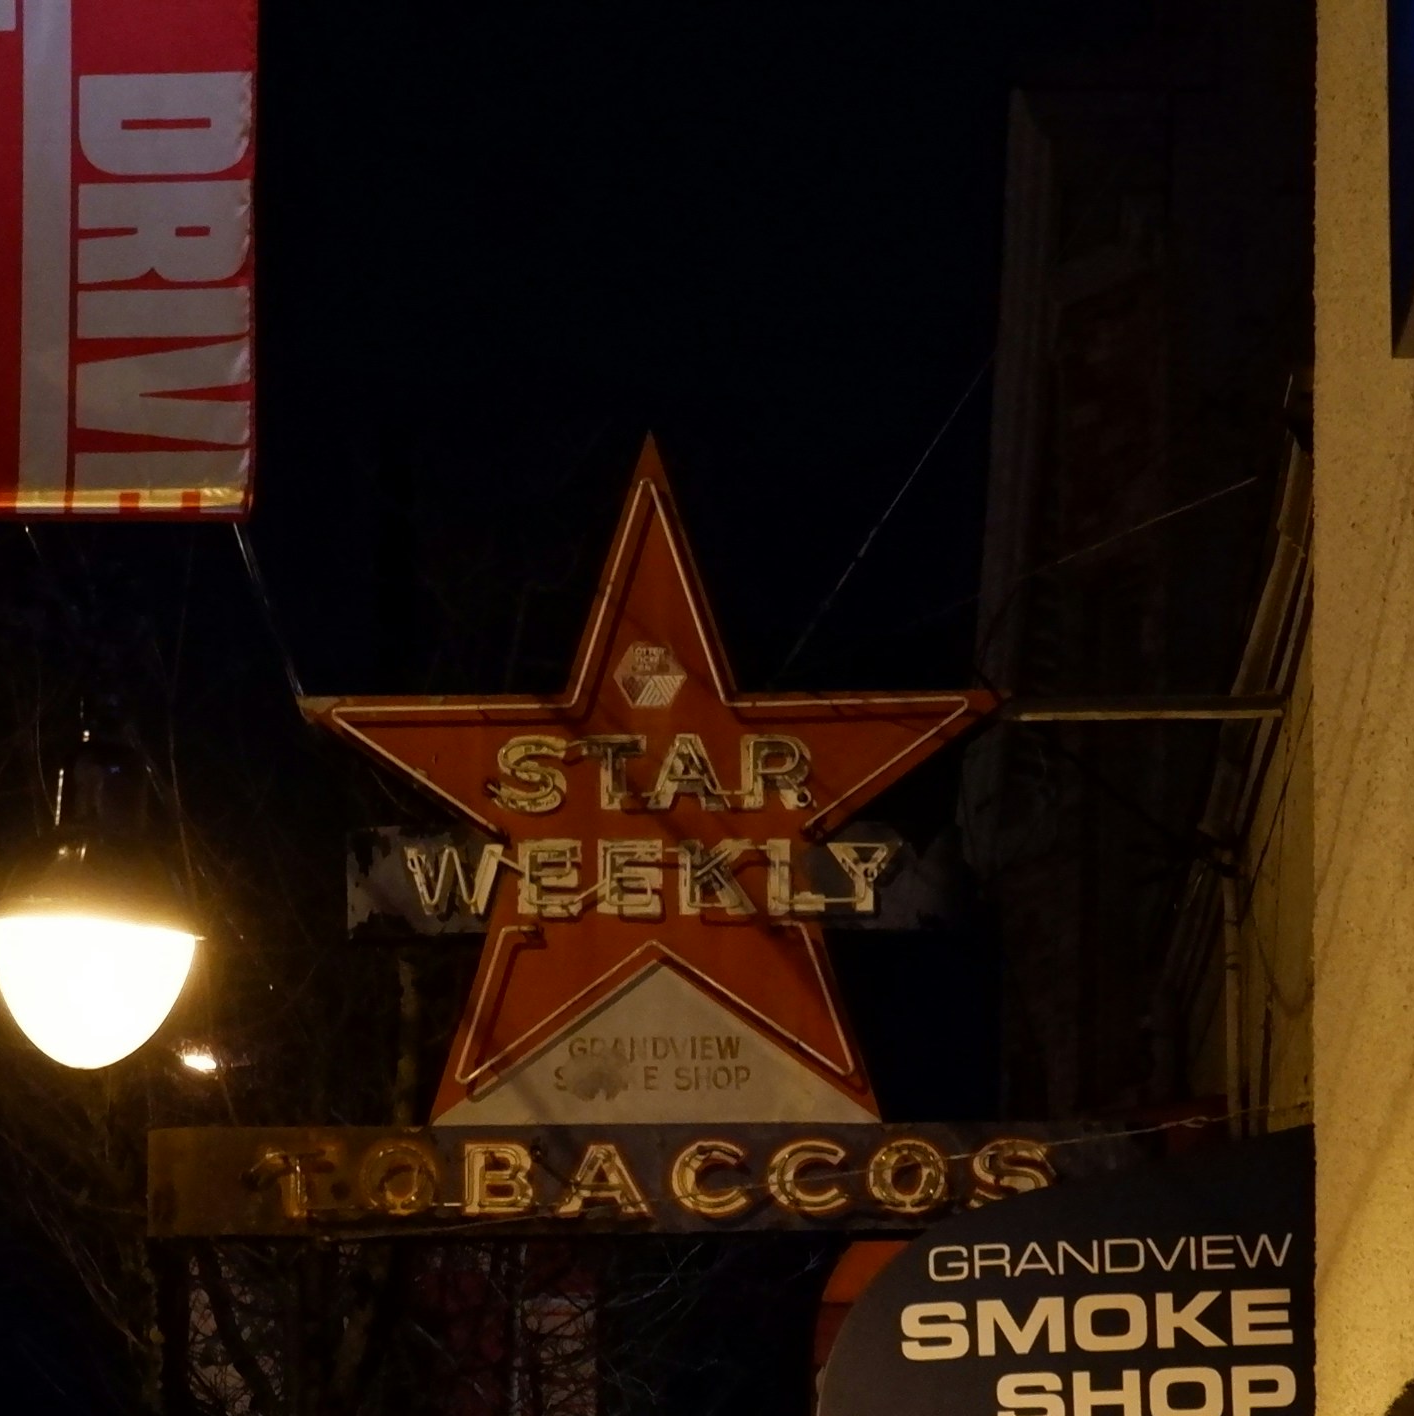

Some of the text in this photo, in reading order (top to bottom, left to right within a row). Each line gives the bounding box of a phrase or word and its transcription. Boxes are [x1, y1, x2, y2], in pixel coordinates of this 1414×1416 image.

[491, 732, 816, 814] STAR
[402, 838, 903, 920] WEEKLY
[674, 1065, 751, 1091] SHOP
[257, 1137, 1059, 1222] TOBACCOS
[926, 1231, 1294, 1284] GRANDVIEW
[899, 1286, 1296, 1363] SMOKE
